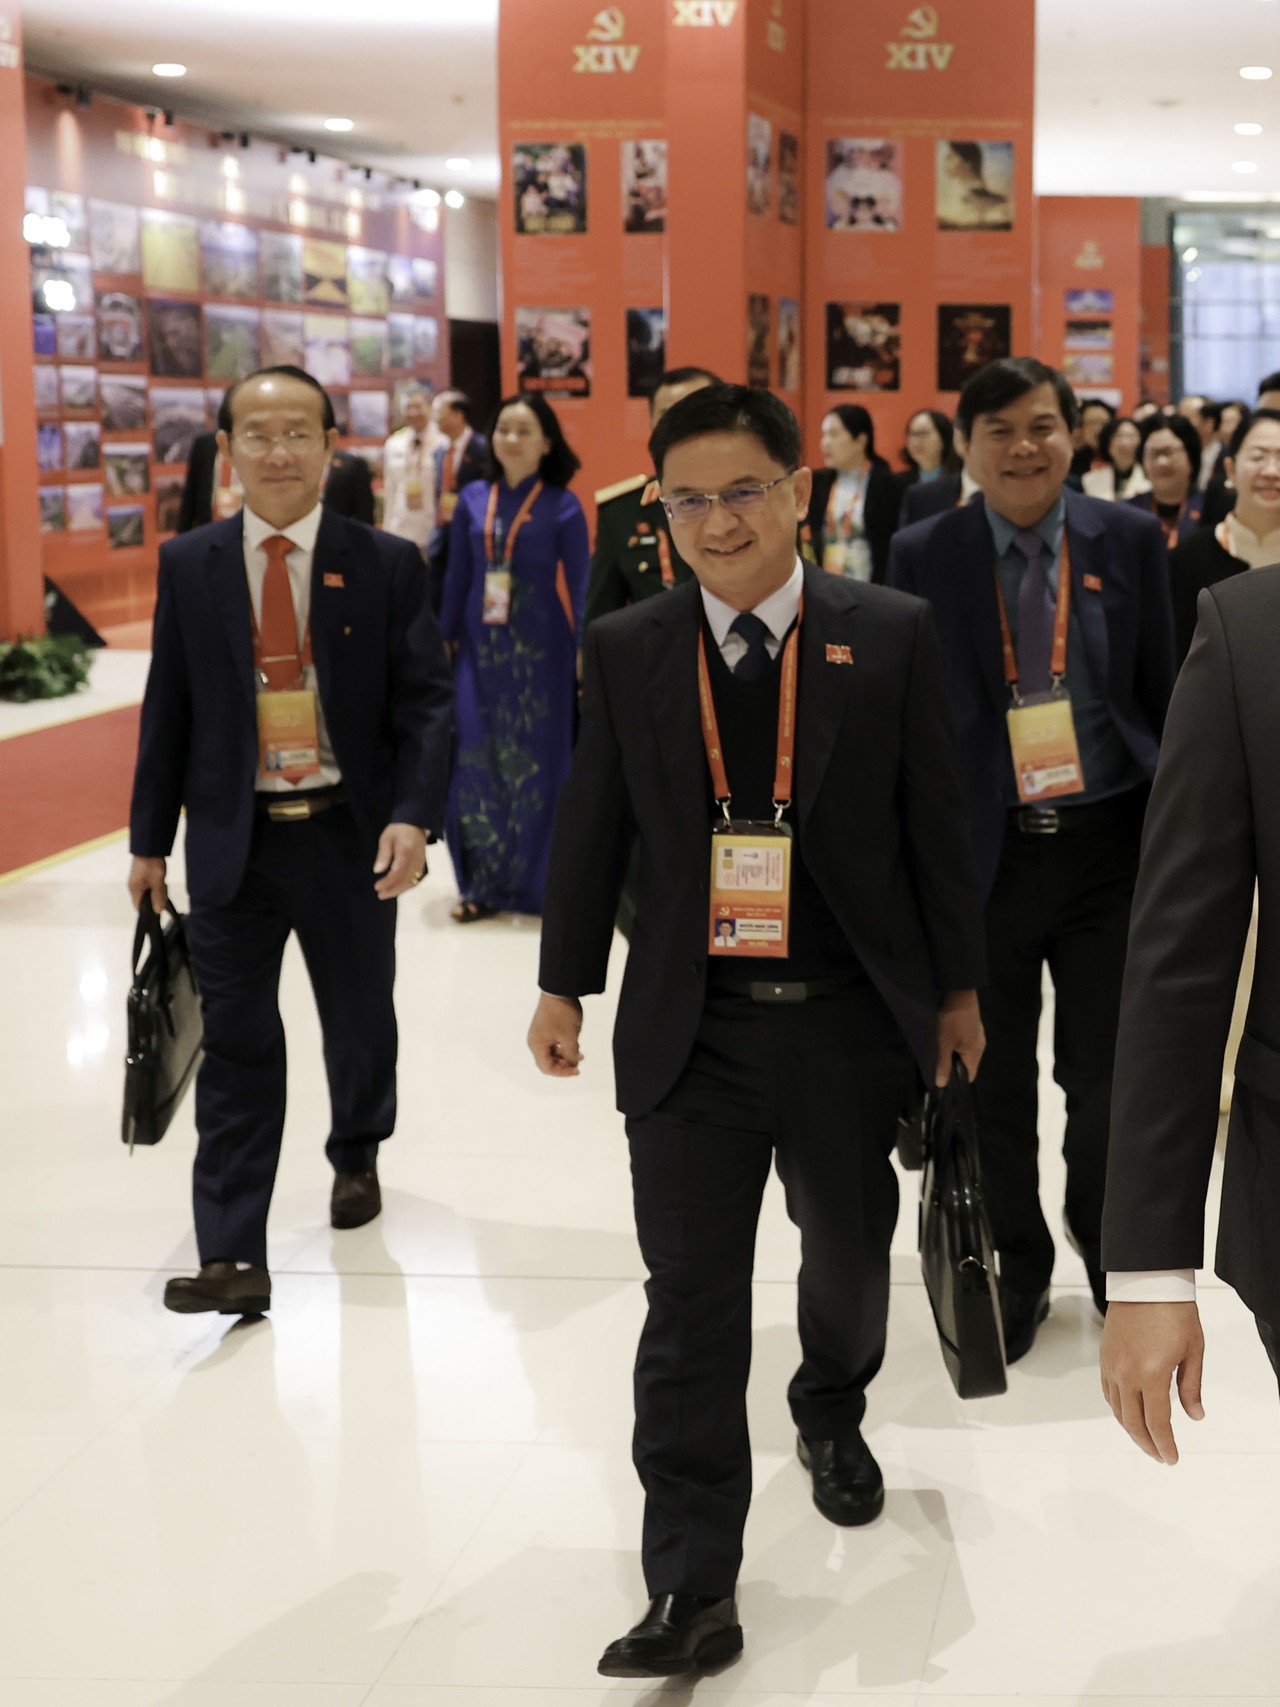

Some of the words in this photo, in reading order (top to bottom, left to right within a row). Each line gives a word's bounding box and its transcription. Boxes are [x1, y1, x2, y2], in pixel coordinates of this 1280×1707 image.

[673, 0, 738, 27] XIV
[572, 44, 641, 73] XIV
[884, 43, 955, 71] XIV
